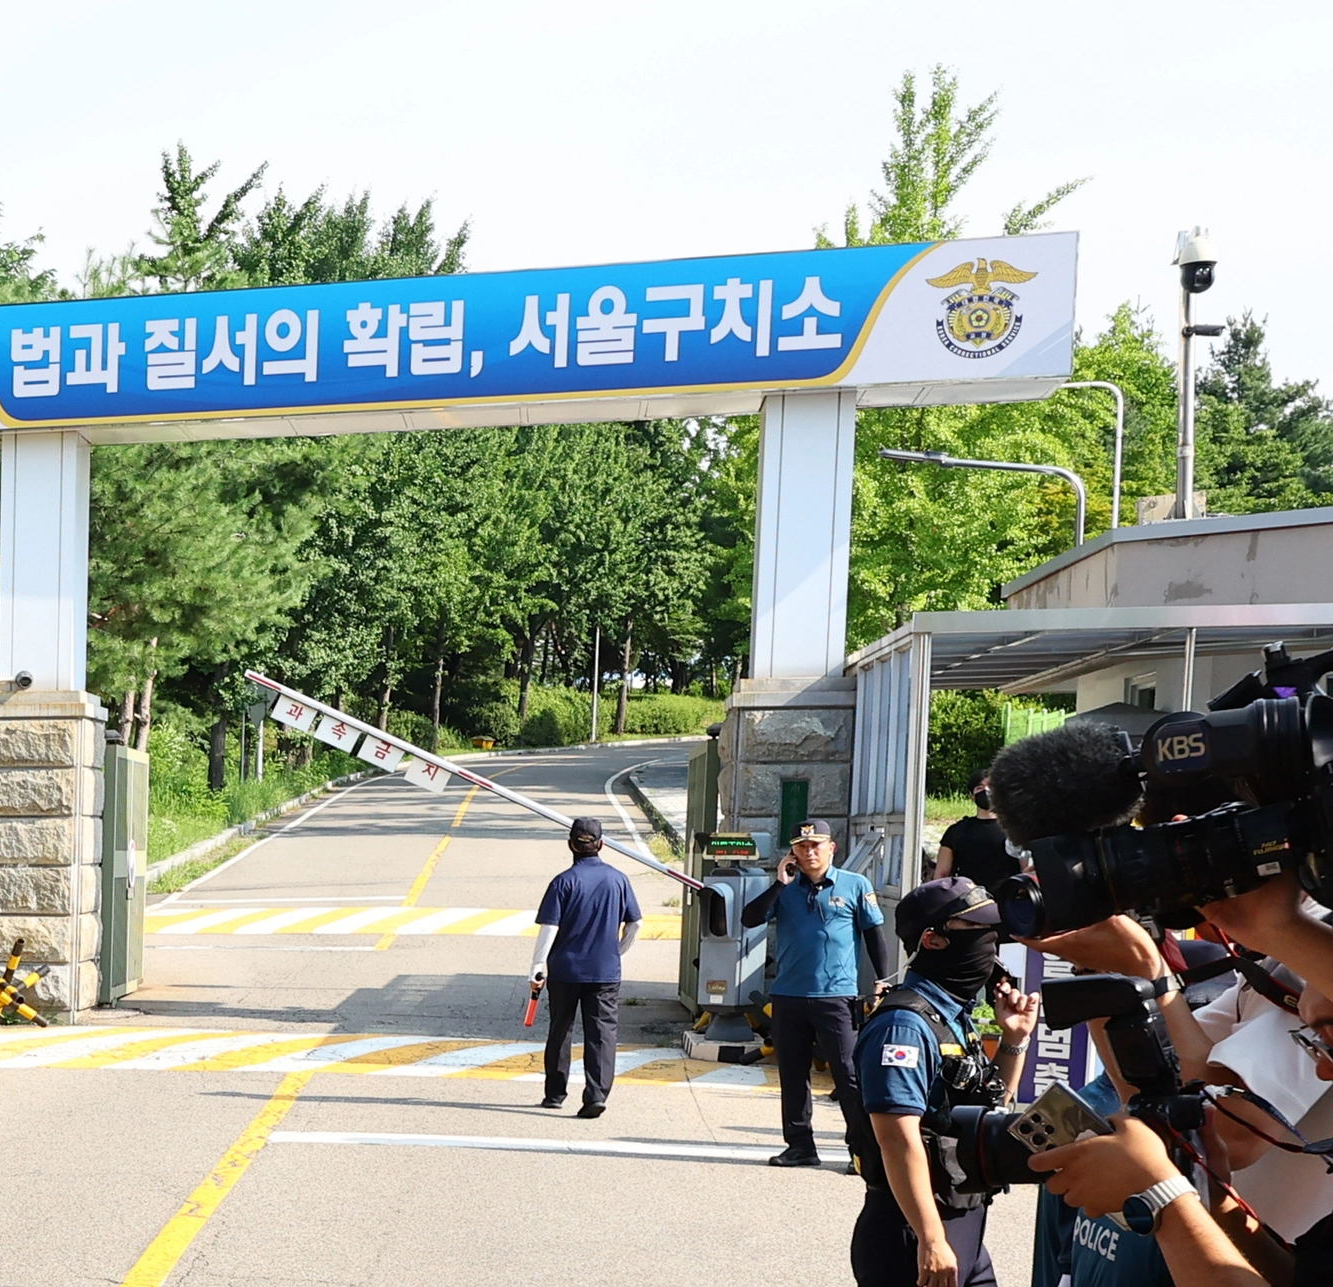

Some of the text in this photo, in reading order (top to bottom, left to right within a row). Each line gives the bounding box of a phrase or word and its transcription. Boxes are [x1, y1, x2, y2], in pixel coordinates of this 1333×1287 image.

[10, 274, 844, 399] 법과 질서의 확립, 서울구치소
[948, 344, 1000, 359] CORRECTIONAL
[1157, 732, 1207, 762] KBS
[1074, 1215, 1119, 1262] POLICE
